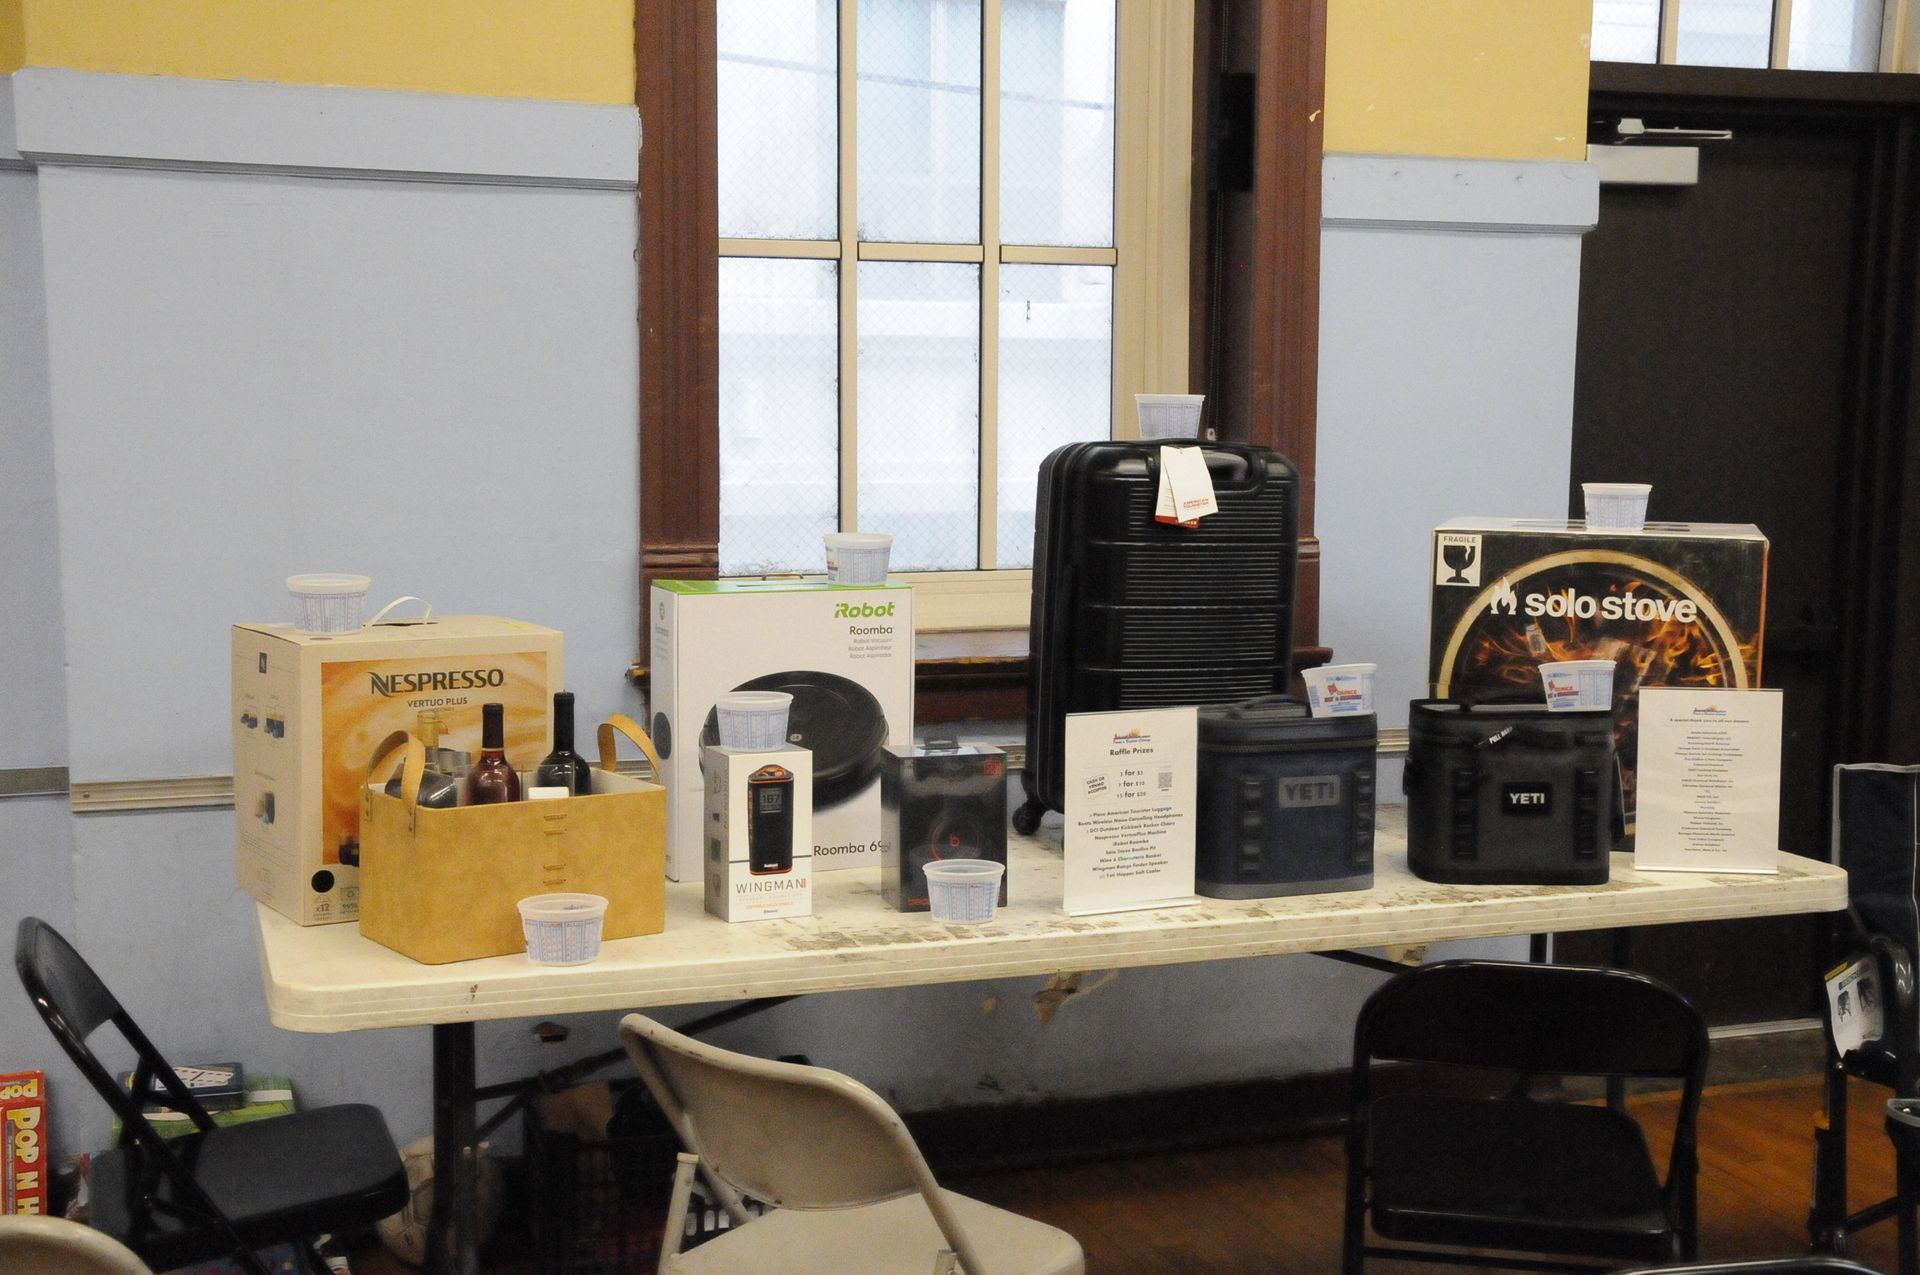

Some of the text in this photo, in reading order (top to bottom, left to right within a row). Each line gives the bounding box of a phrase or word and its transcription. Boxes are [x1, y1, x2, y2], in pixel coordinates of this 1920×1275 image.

[1443, 535, 1477, 544] FRAGILE
[834, 601, 896, 619] iRobot
[1524, 587, 1697, 624] solo stove
[849, 624, 893, 635] Roomba
[366, 668, 505, 698] NESPRESSO
[407, 696, 468, 708] VERTUO PLUS
[1109, 746, 1154, 757] Raffle Prizes
[1284, 781, 1335, 801] YETI
[1509, 792, 1545, 805] YETI
[813, 842, 866, 856] Roomba
[735, 878, 804, 894] WINGMAN
[6, 1106, 41, 1164] POP
[16, 1170, 39, 1191] N
